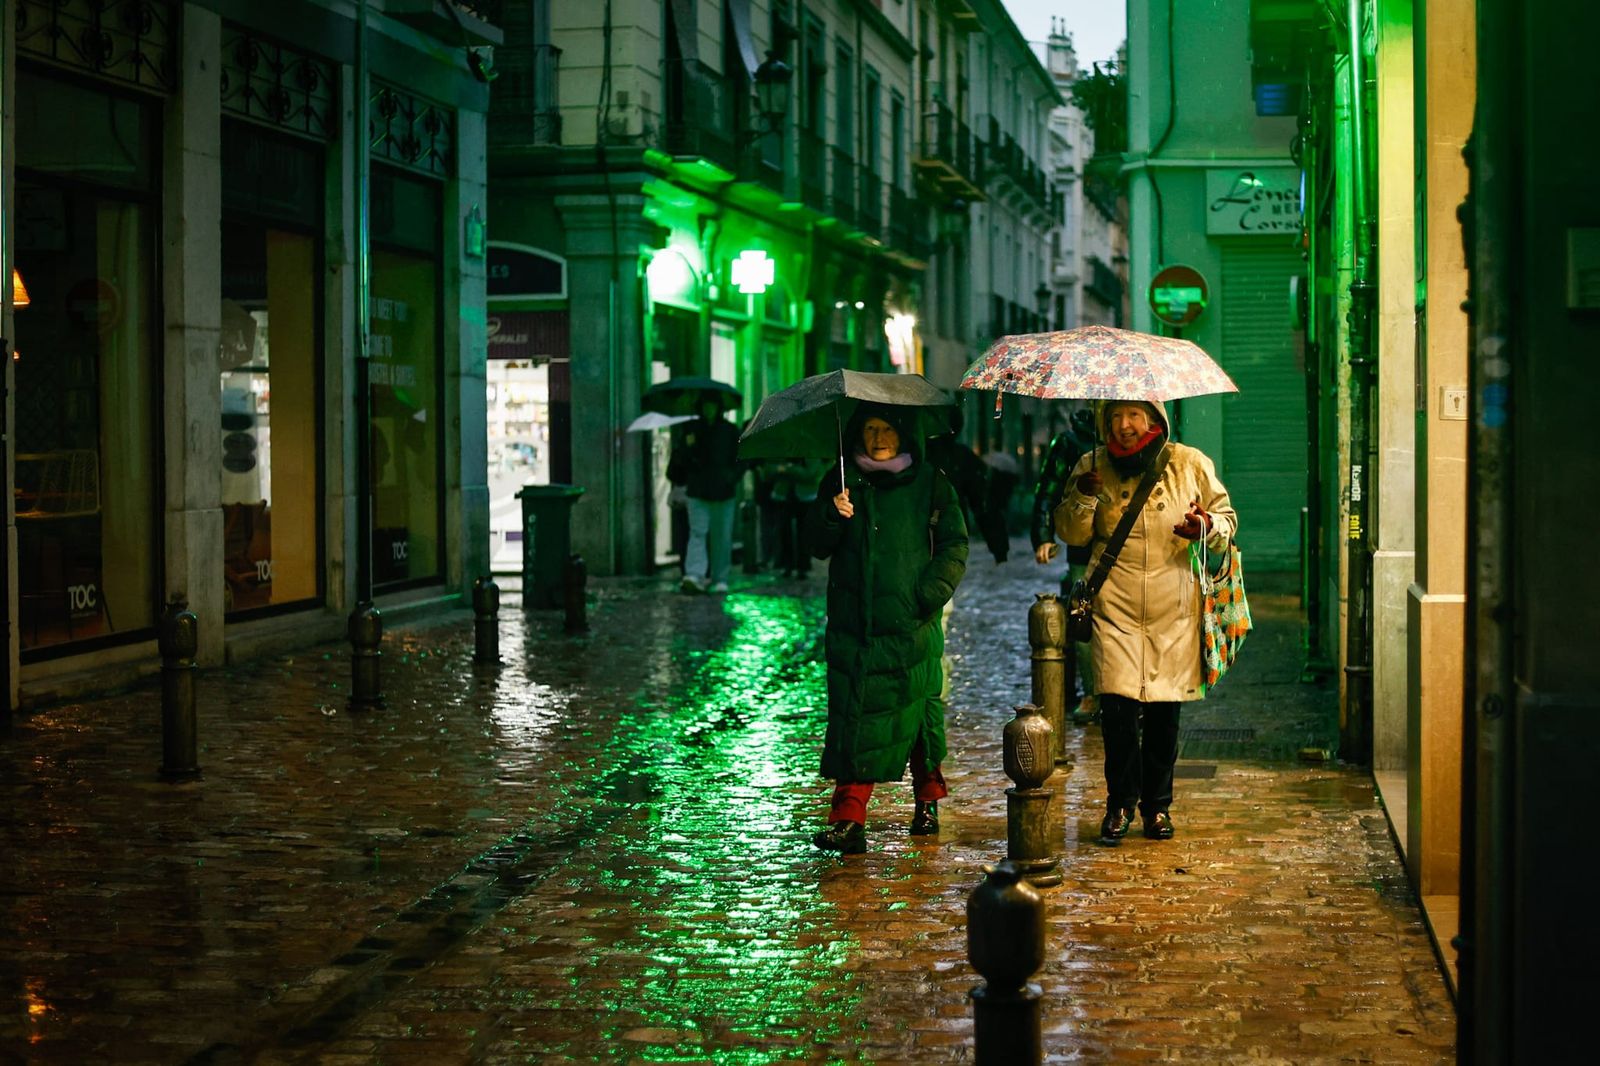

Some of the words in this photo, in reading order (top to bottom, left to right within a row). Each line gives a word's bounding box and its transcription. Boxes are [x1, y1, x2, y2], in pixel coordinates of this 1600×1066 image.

[487, 264, 510, 278] ES
[391, 541, 408, 560] TOC
[67, 583, 97, 610] TOC
